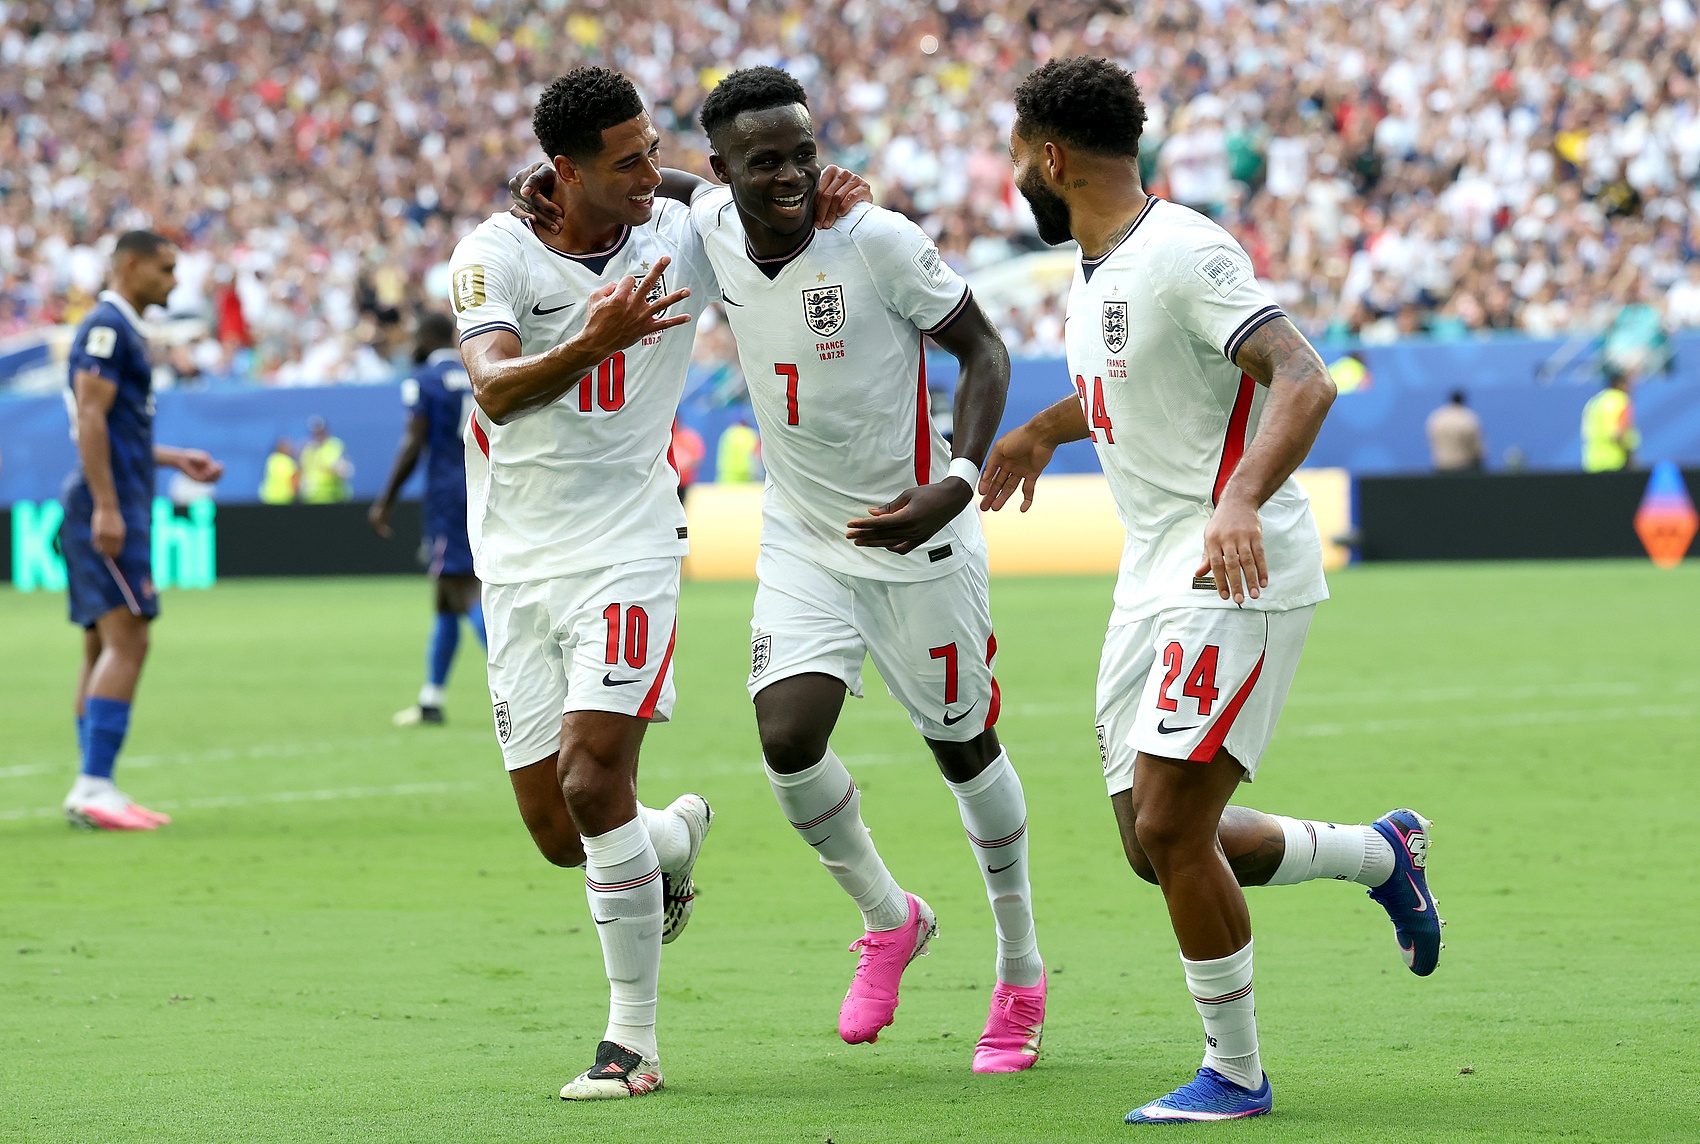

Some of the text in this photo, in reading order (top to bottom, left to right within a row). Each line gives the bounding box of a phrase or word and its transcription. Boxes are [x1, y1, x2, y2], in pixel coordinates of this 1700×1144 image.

[1202, 253, 1227, 273] FOOTBALL
[1207, 257, 1234, 279] UNITES
[1215, 278, 1226, 287] the
[815, 340, 845, 351] FRANCE
[819, 350, 845, 361] 18.07.26
[1106, 359, 1127, 368] FRANCE
[579, 351, 626, 412] 10
[774, 363, 799, 425] 7
[11, 496, 217, 593] Khi
[603, 602, 649, 669] 10
[929, 641, 958, 705] 7
[1156, 641, 1220, 716] 24
